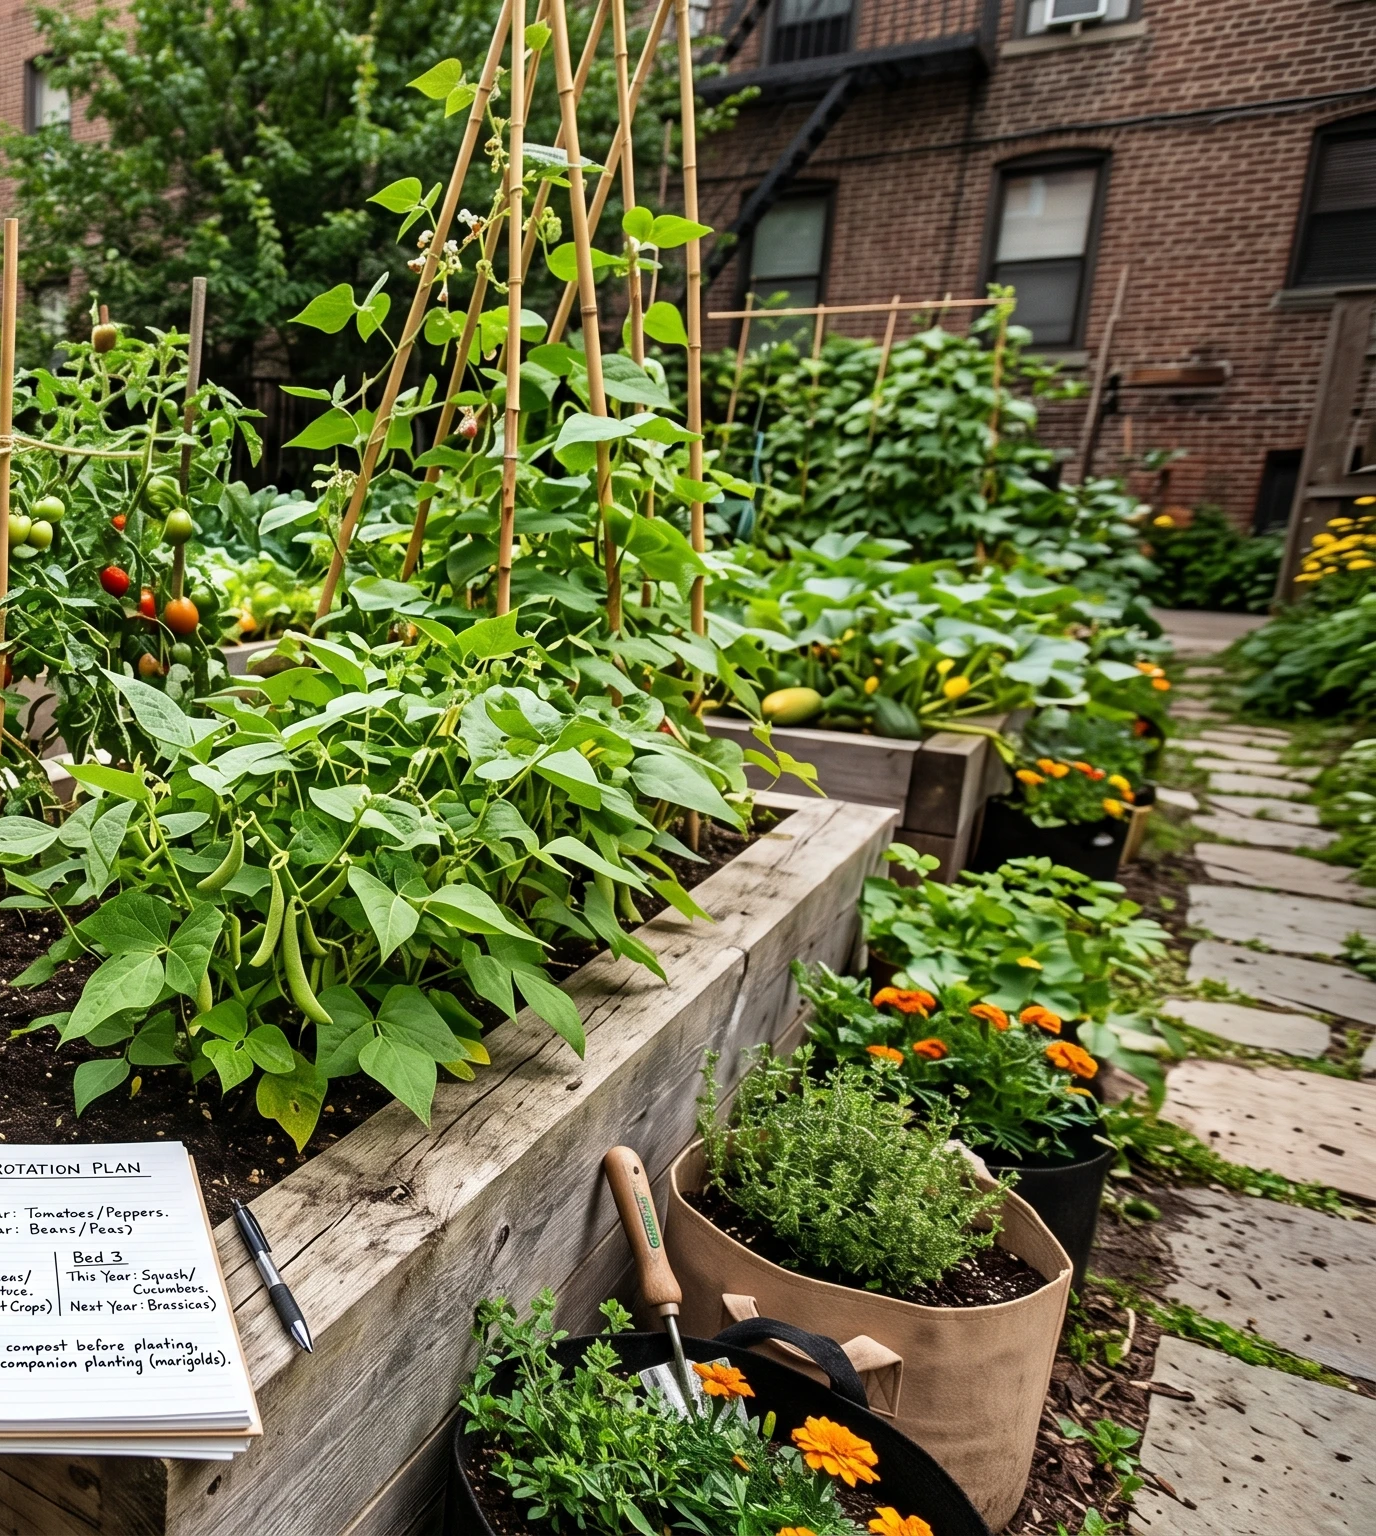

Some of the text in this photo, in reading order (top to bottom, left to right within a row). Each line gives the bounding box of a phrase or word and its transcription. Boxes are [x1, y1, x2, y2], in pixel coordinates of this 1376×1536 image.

[93, 1162, 140, 1174] PLAN
[73, 1251, 122, 1263] Bed 3
[66, 1271, 95, 1281] This
[71, 1301, 103, 1311] Next
[6, 1340, 67, 1355] compost
[77, 1339, 124, 1351] before
[135, 1338, 197, 1357] planting,
[1, 1357, 77, 1372] companion
[85, 1355, 142, 1375] planting
[150, 1350, 230, 1372] (marigolds).
